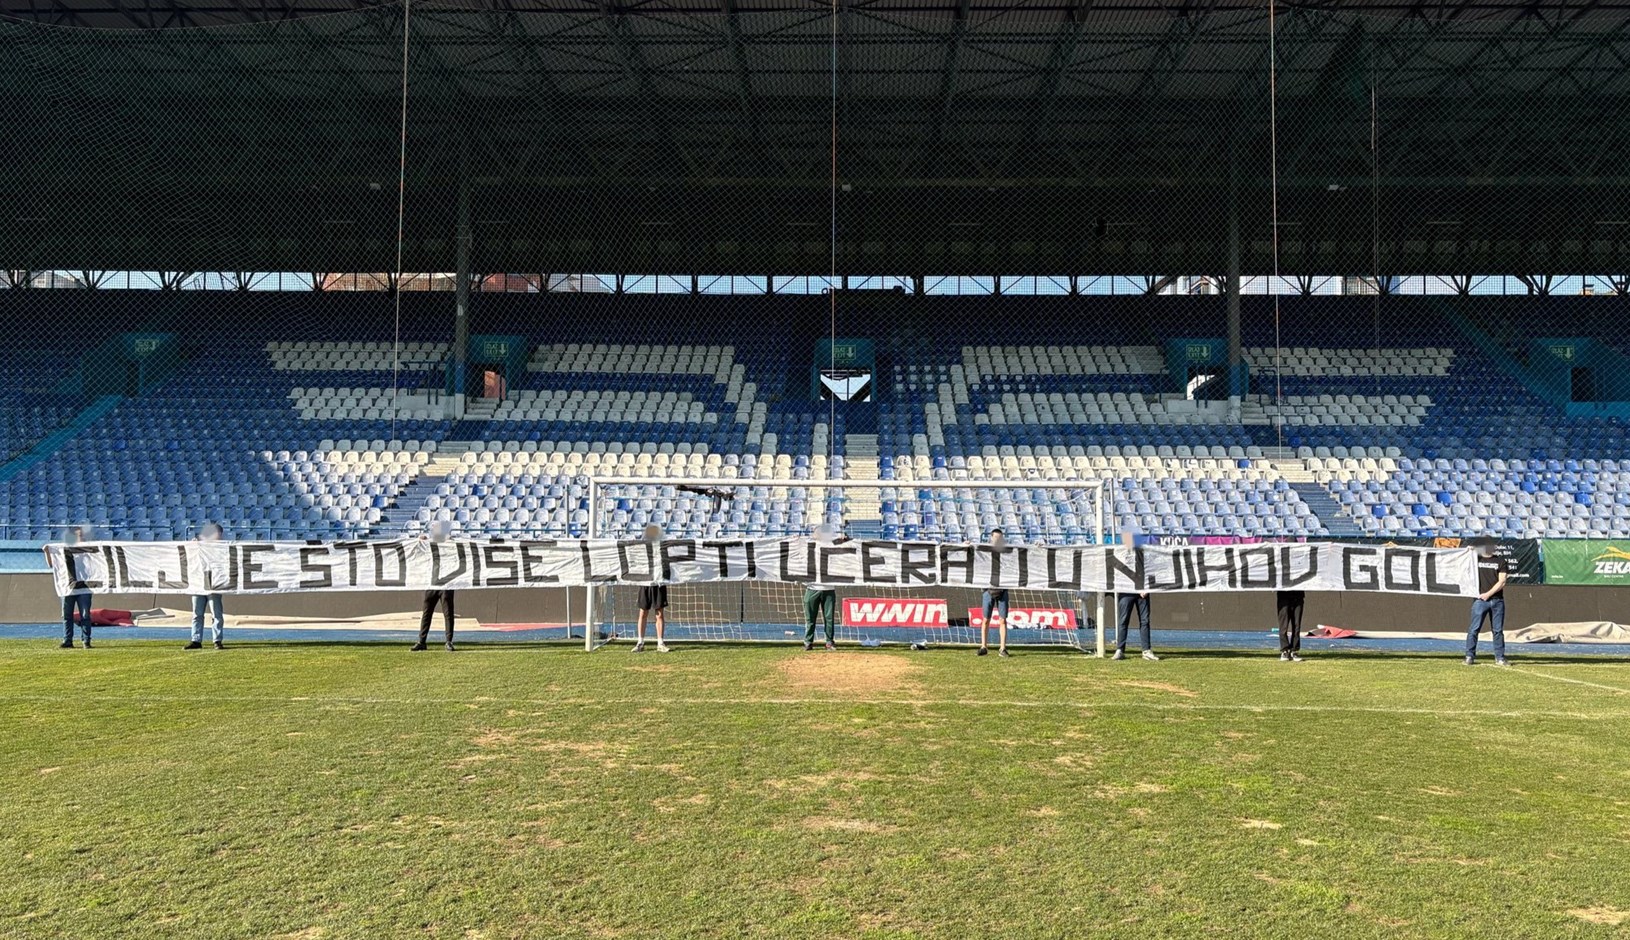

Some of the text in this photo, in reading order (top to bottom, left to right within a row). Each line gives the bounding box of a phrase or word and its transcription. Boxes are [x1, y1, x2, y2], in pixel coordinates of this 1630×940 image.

[64, 545, 189, 589] CILJ
[204, 545, 279, 590] JE
[299, 540, 406, 588] ŠTO
[430, 538, 560, 587] VIŠE
[581, 539, 756, 582] LOPTI
[1047, 549, 1082, 590] U
[1105, 546, 1318, 590] NJIHOV
[1343, 547, 1461, 595] GOL
